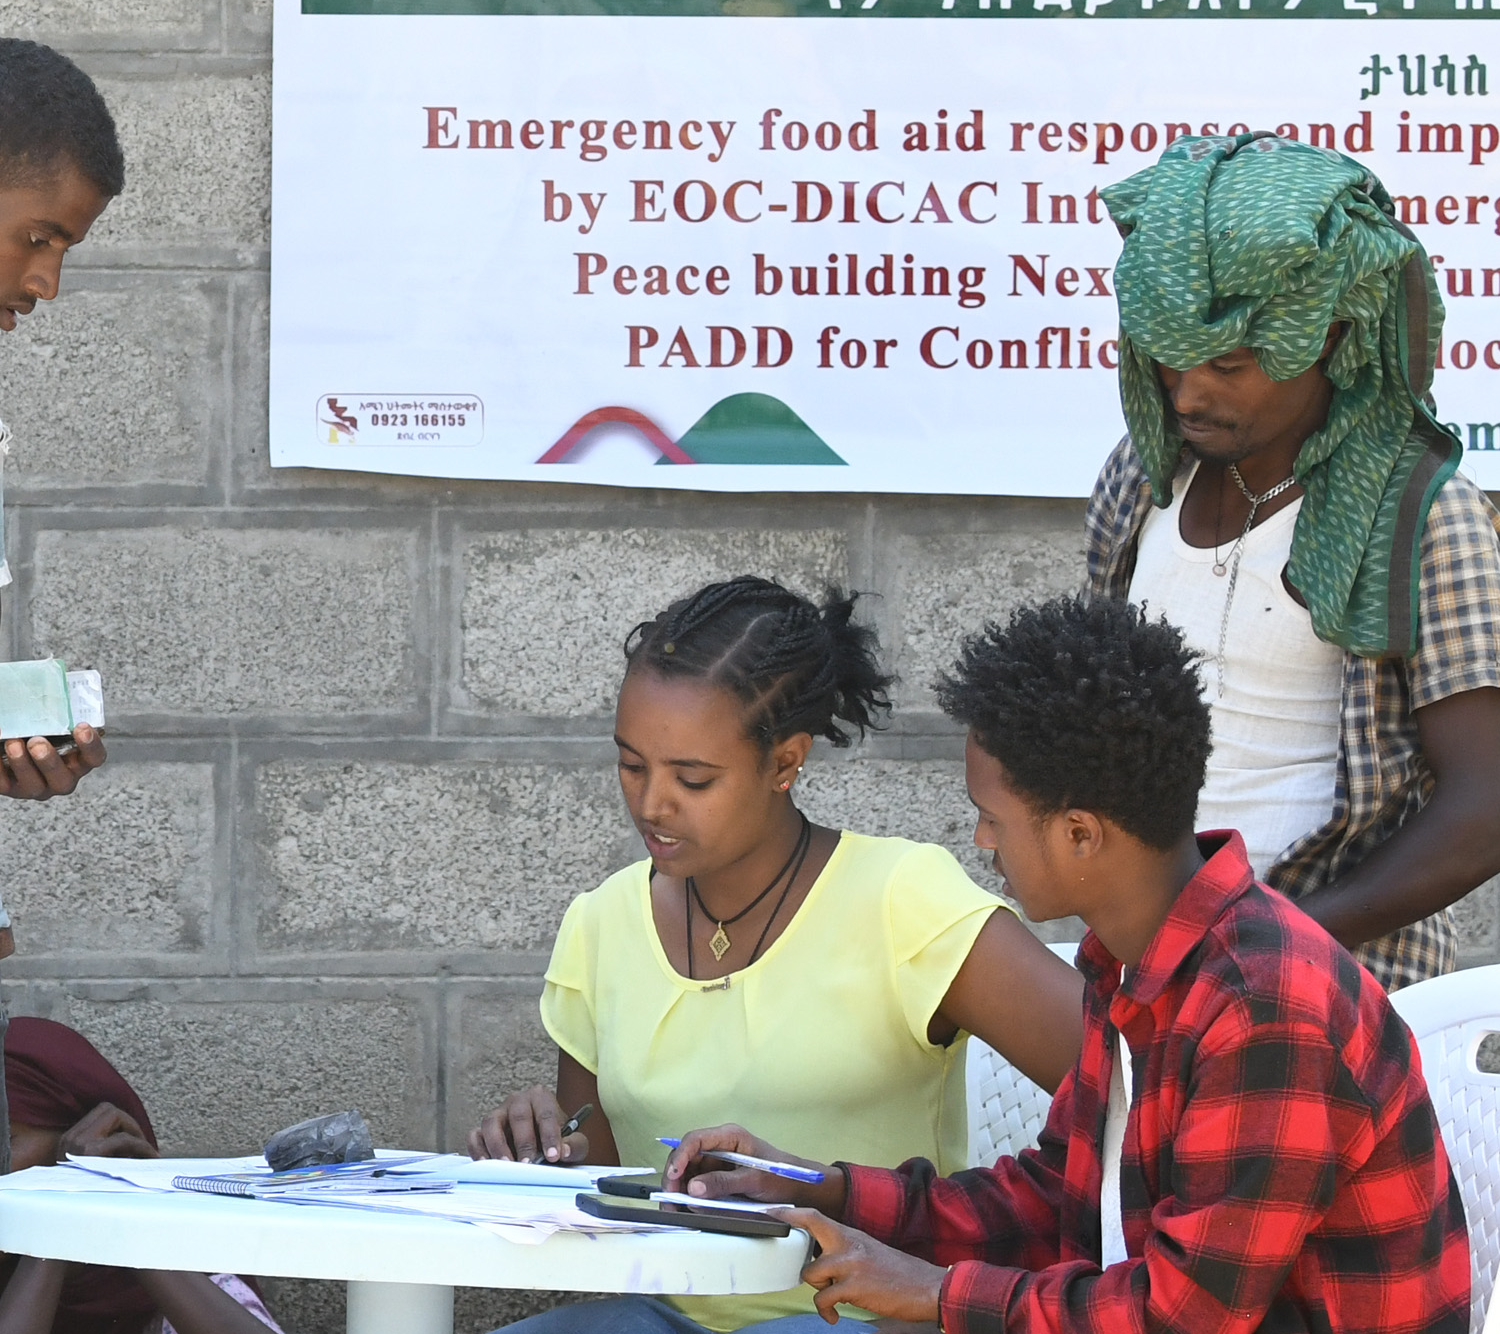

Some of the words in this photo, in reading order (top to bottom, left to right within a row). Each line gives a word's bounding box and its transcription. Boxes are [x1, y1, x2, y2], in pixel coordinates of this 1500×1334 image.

[1359, 53, 1489, 101] ታህሳስ
[422, 106, 738, 164] Emergency
[758, 108, 880, 152] food
[902, 108, 987, 152] aid
[541, 180, 609, 236] by
[629, 179, 998, 224] EOC-DICAC
[1021, 182, 1103, 224] Int
[572, 252, 730, 296] Peace
[751, 252, 987, 309] building
[1007, 254, 1113, 298] Nex
[624, 325, 794, 368] PADD
[816, 325, 899, 369] for
[919, 325, 1119, 370] Conflic
[371, 413, 408, 427] 0923
[414, 413, 467, 427] 166155
